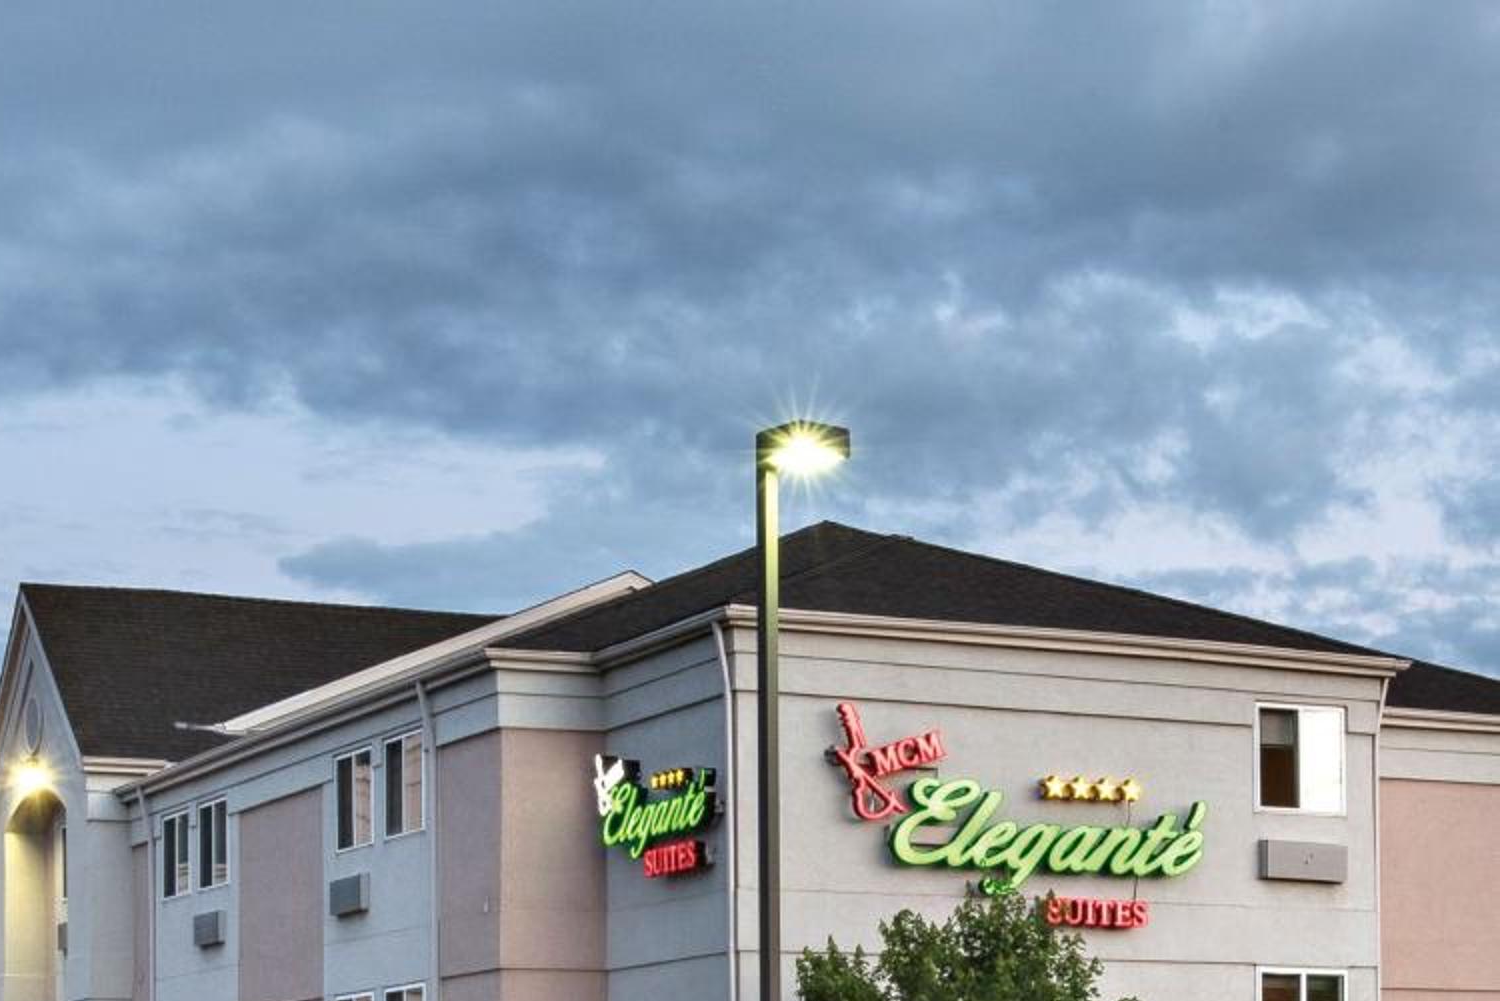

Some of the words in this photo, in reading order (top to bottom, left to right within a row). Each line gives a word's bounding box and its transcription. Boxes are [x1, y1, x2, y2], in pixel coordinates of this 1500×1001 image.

[873, 732, 945, 776] MCM
[643, 839, 696, 878] SUITES
[1044, 897, 1150, 930] SUITES
